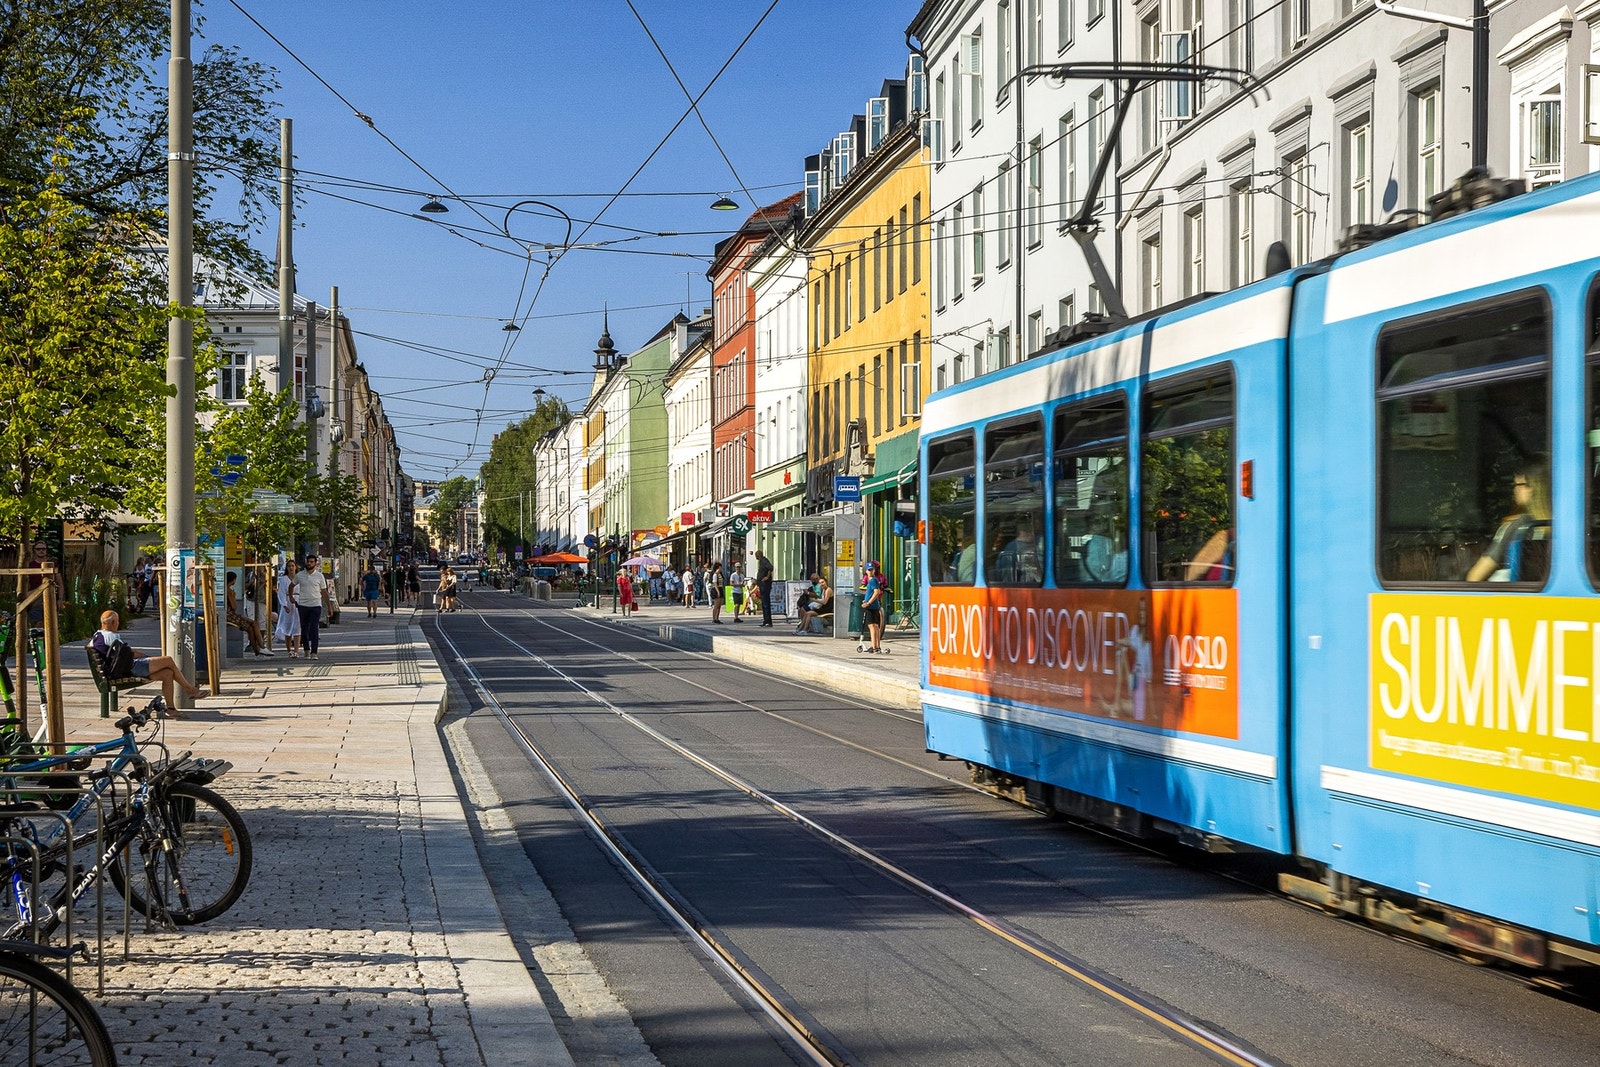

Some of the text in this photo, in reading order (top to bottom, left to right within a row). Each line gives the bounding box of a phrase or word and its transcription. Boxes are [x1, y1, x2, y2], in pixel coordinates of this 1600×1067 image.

[929, 603, 958, 655] FOR
[961, 604, 994, 660] YOU
[997, 606, 1022, 663] TO
[1181, 635, 1228, 670] OSLO
